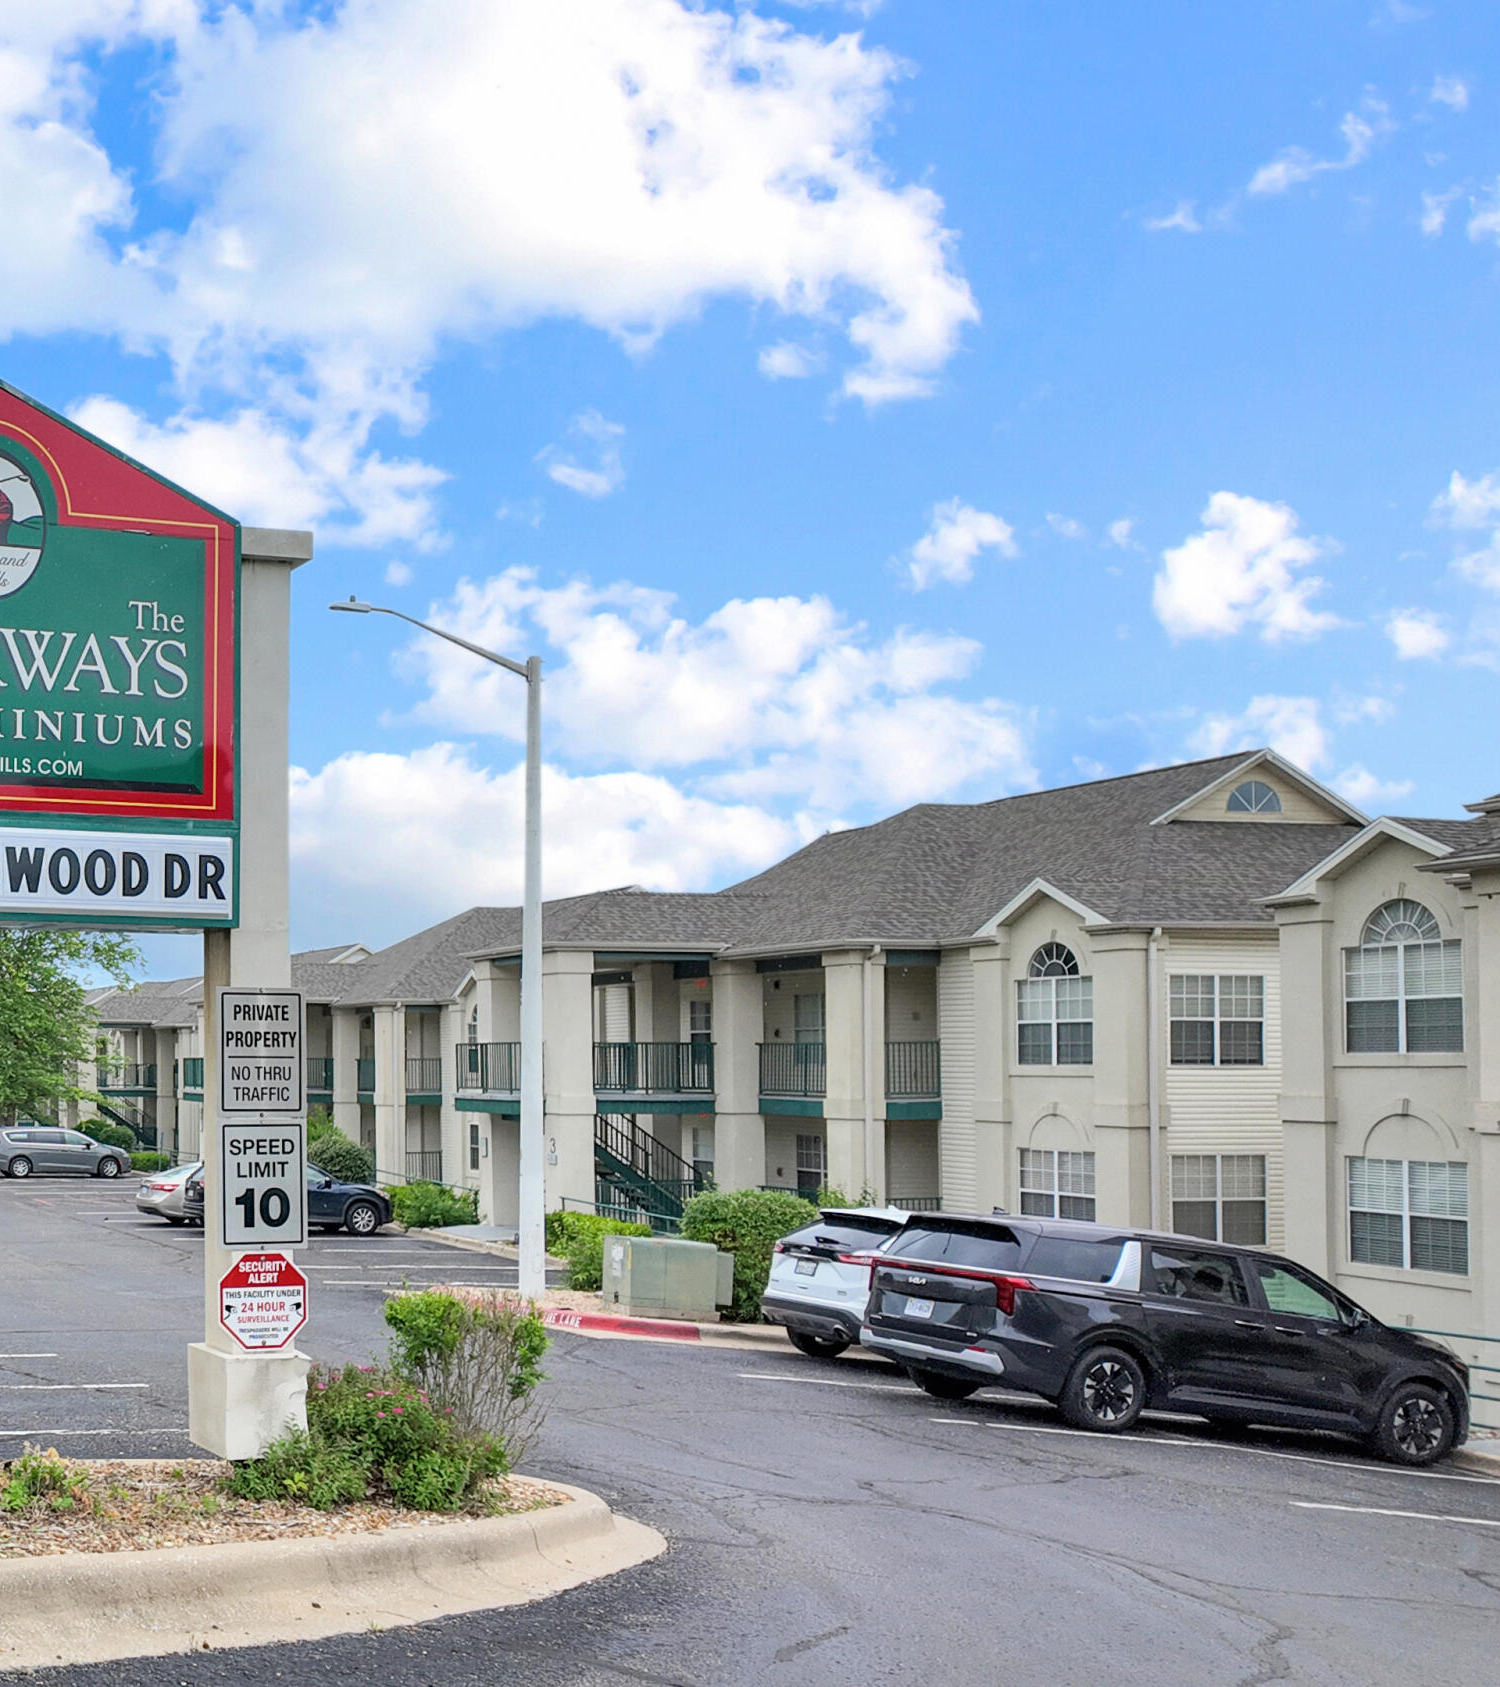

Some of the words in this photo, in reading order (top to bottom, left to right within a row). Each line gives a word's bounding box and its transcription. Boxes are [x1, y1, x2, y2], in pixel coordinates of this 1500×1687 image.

[128, 600, 185, 634] The
[163, 852, 226, 900] DR
[233, 1004, 290, 1021] PRIVATE
[226, 1030, 297, 1048] PROPERTY
[231, 1066, 251, 1081] NO
[254, 1066, 292, 1081] THRU
[232, 1086, 290, 1102] TRAFFIC
[229, 1138, 295, 1156] SPEED
[236, 1161, 289, 1178] LIMIT
[235, 1187, 291, 1228] 10
[239, 1261, 287, 1272] SECURITY
[248, 1273, 278, 1283] ALERT
[241, 1303, 253, 1312] 24
[257, 1302, 285, 1312] HOUR
[237, 1315, 289, 1323] SURVEILLANCE
